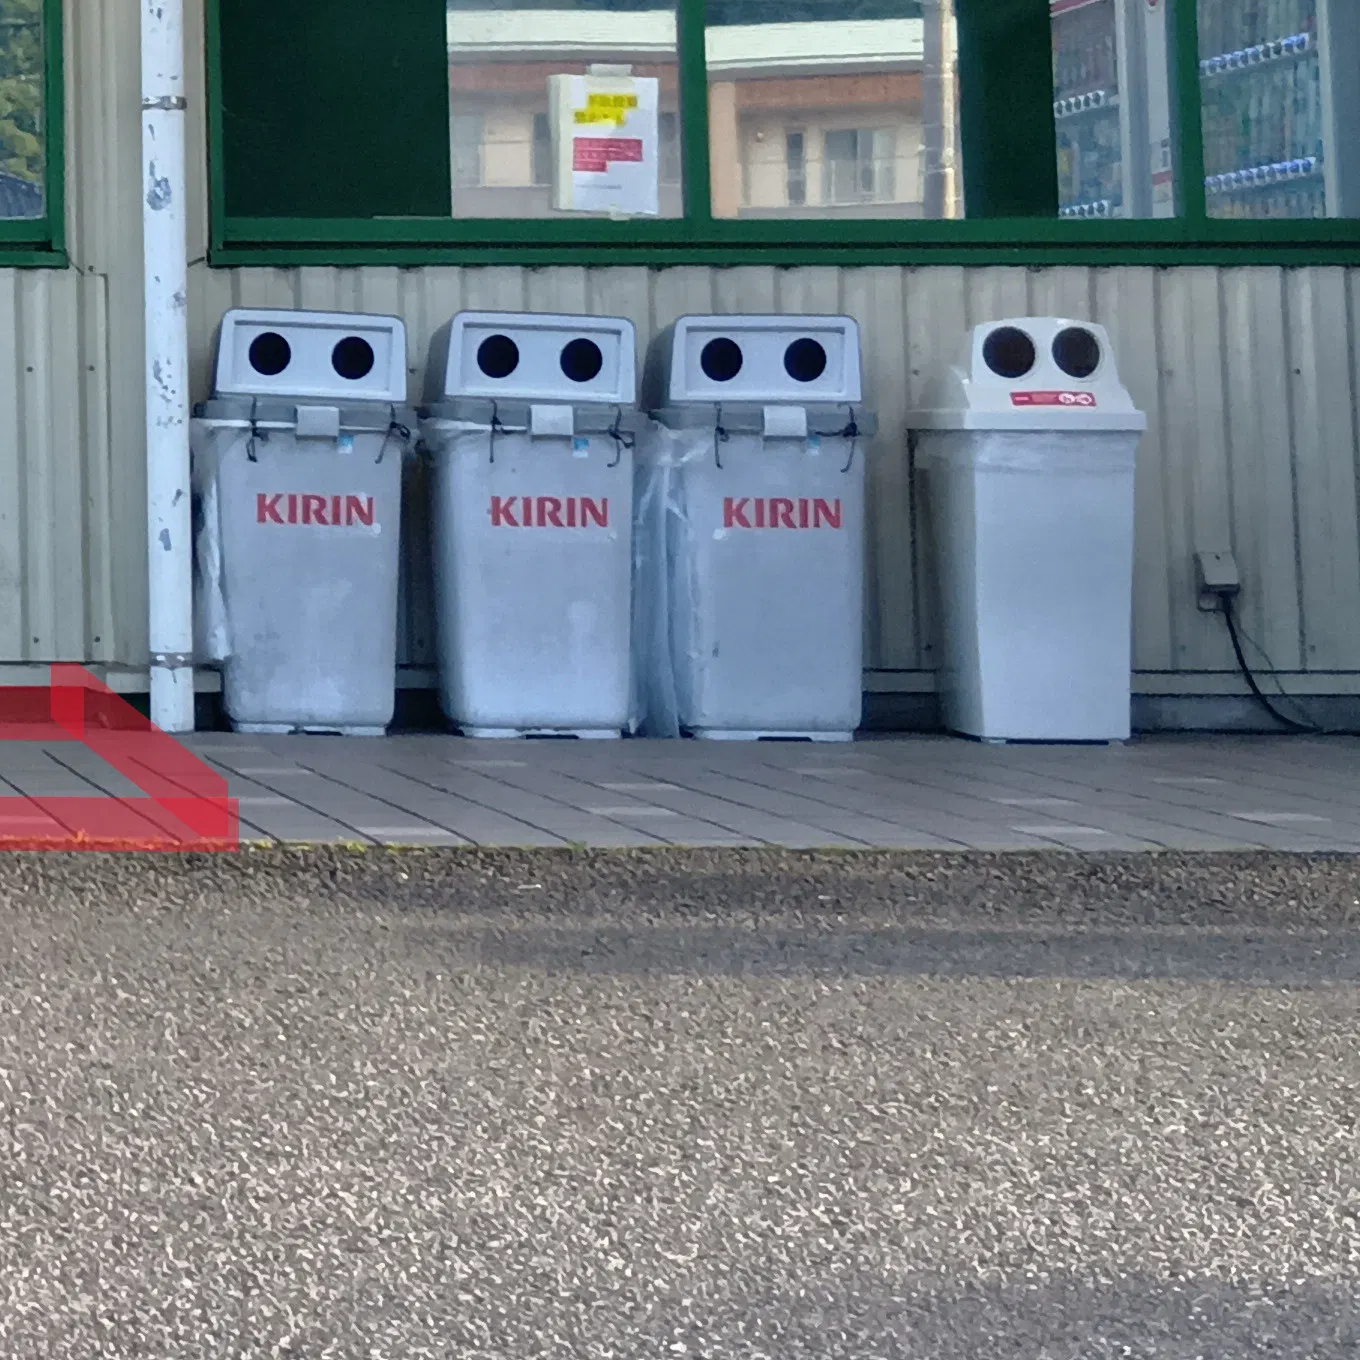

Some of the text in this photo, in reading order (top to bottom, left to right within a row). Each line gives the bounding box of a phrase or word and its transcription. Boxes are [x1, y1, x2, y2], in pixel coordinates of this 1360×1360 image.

[256, 493, 375, 526] KIRIN
[490, 495, 609, 528] KIRIN
[722, 497, 842, 529] KIRIN
